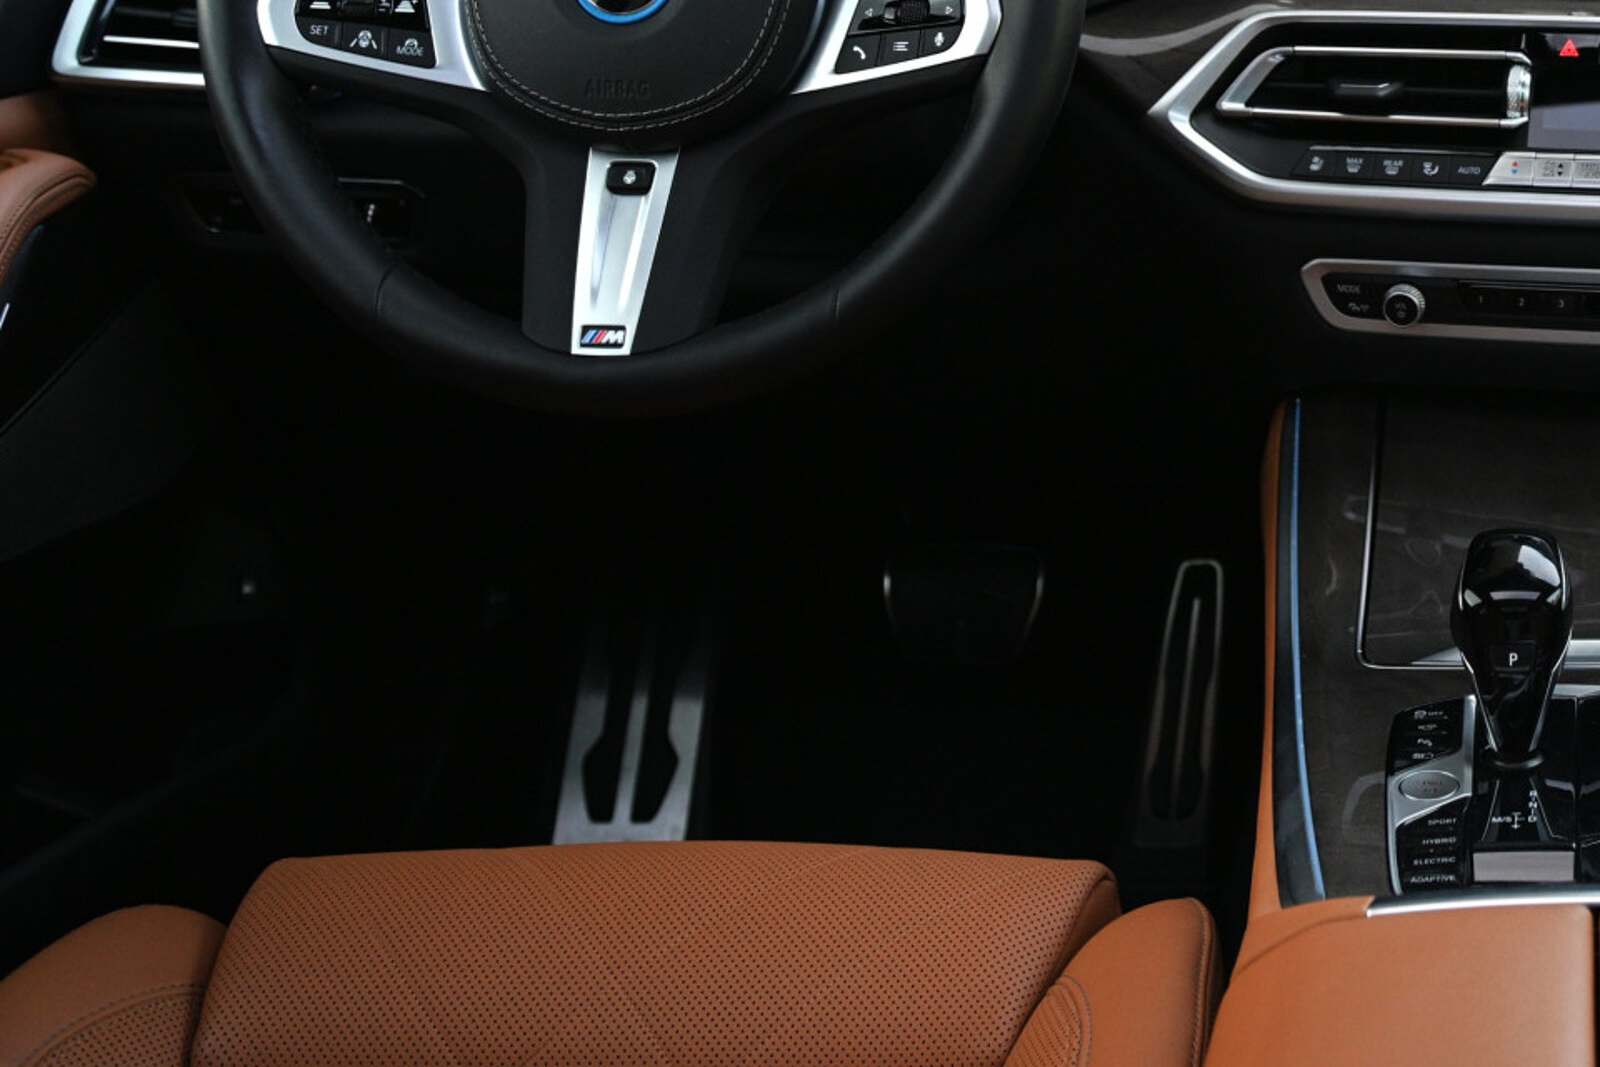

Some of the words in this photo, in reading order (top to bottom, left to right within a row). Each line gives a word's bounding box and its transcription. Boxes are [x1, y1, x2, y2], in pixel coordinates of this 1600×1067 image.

[309, 24, 330, 36] SET
[396, 46, 425, 57] MODE
[1457, 166, 1481, 175] AUTO
[1508, 651, 1519, 667] P
[1427, 817, 1458, 826] SPORT
[1421, 836, 1458, 846] HYBRID
[1412, 856, 1457, 866] ELECTRIC
[1409, 874, 1456, 884] ADAPTIVE
